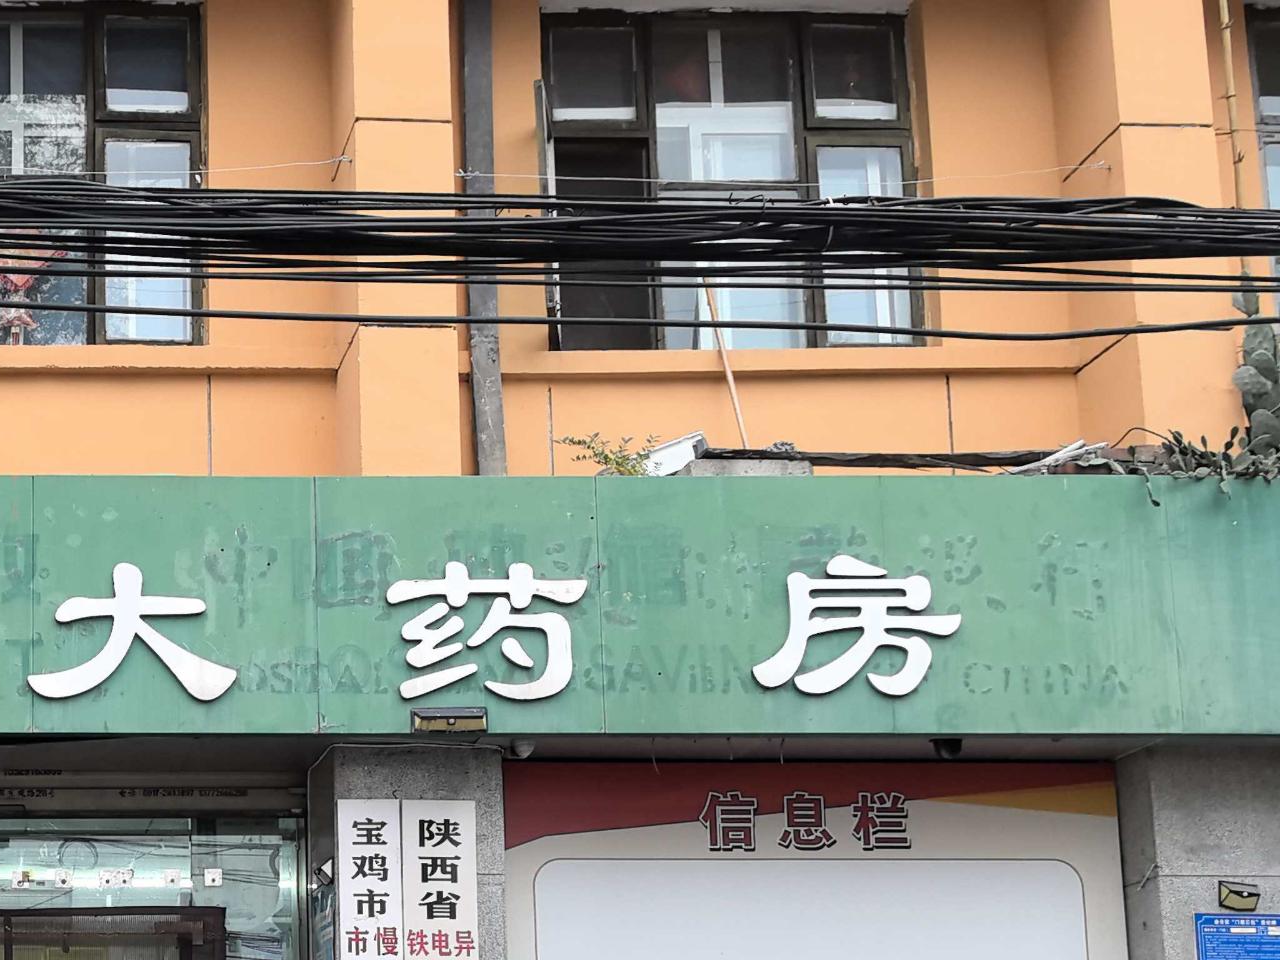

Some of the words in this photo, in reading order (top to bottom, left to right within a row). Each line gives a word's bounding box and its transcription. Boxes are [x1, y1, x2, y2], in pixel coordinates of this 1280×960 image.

[351, 817, 389, 918] 宝鸡市
[418, 819, 462, 920] 陕西省
[698, 791, 912, 852] 信息栏
